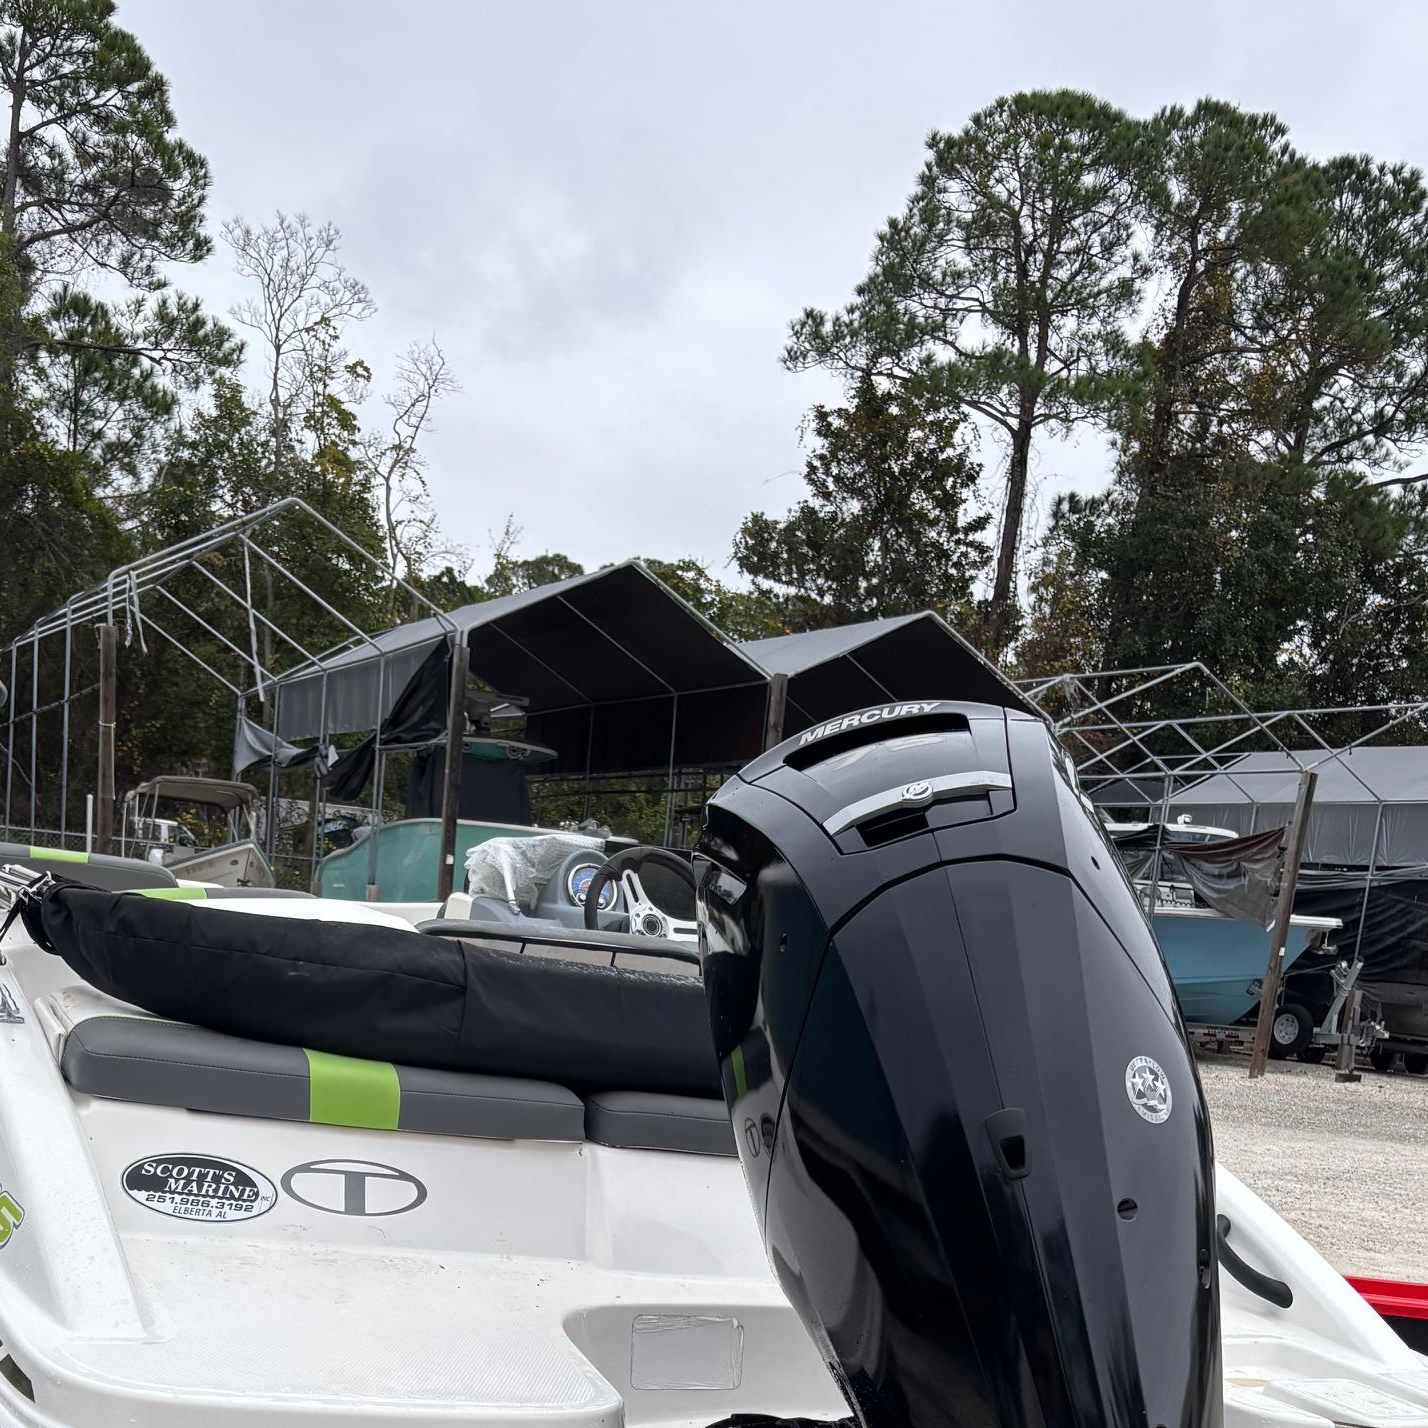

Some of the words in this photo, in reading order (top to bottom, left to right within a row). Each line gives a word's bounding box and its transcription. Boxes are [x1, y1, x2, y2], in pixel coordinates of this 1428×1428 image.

[798, 702, 941, 746] MERCURY
[141, 1162, 236, 1185] SCOTT'S
[164, 1178, 258, 1201] MARINE
[145, 1193, 255, 1213] 251.986.3192
[172, 1206, 213, 1218] ELBERTA
[215, 1209, 228, 1219] AL
